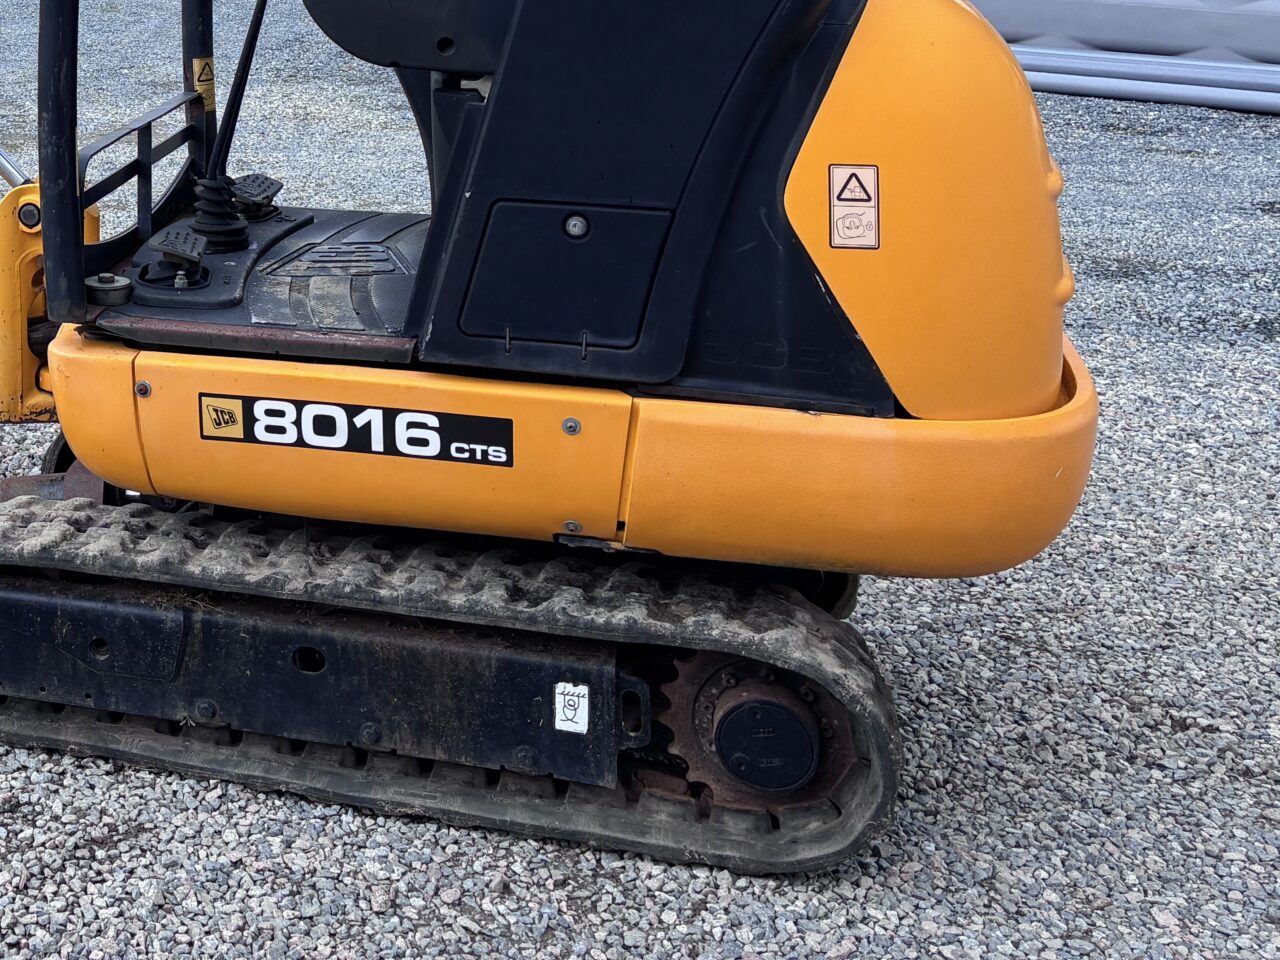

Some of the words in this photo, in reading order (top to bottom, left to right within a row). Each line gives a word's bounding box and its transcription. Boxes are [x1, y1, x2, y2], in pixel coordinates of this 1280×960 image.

[212, 407, 236, 426] JCB
[253, 399, 441, 457] 8016
[450, 442, 507, 463] CTS
